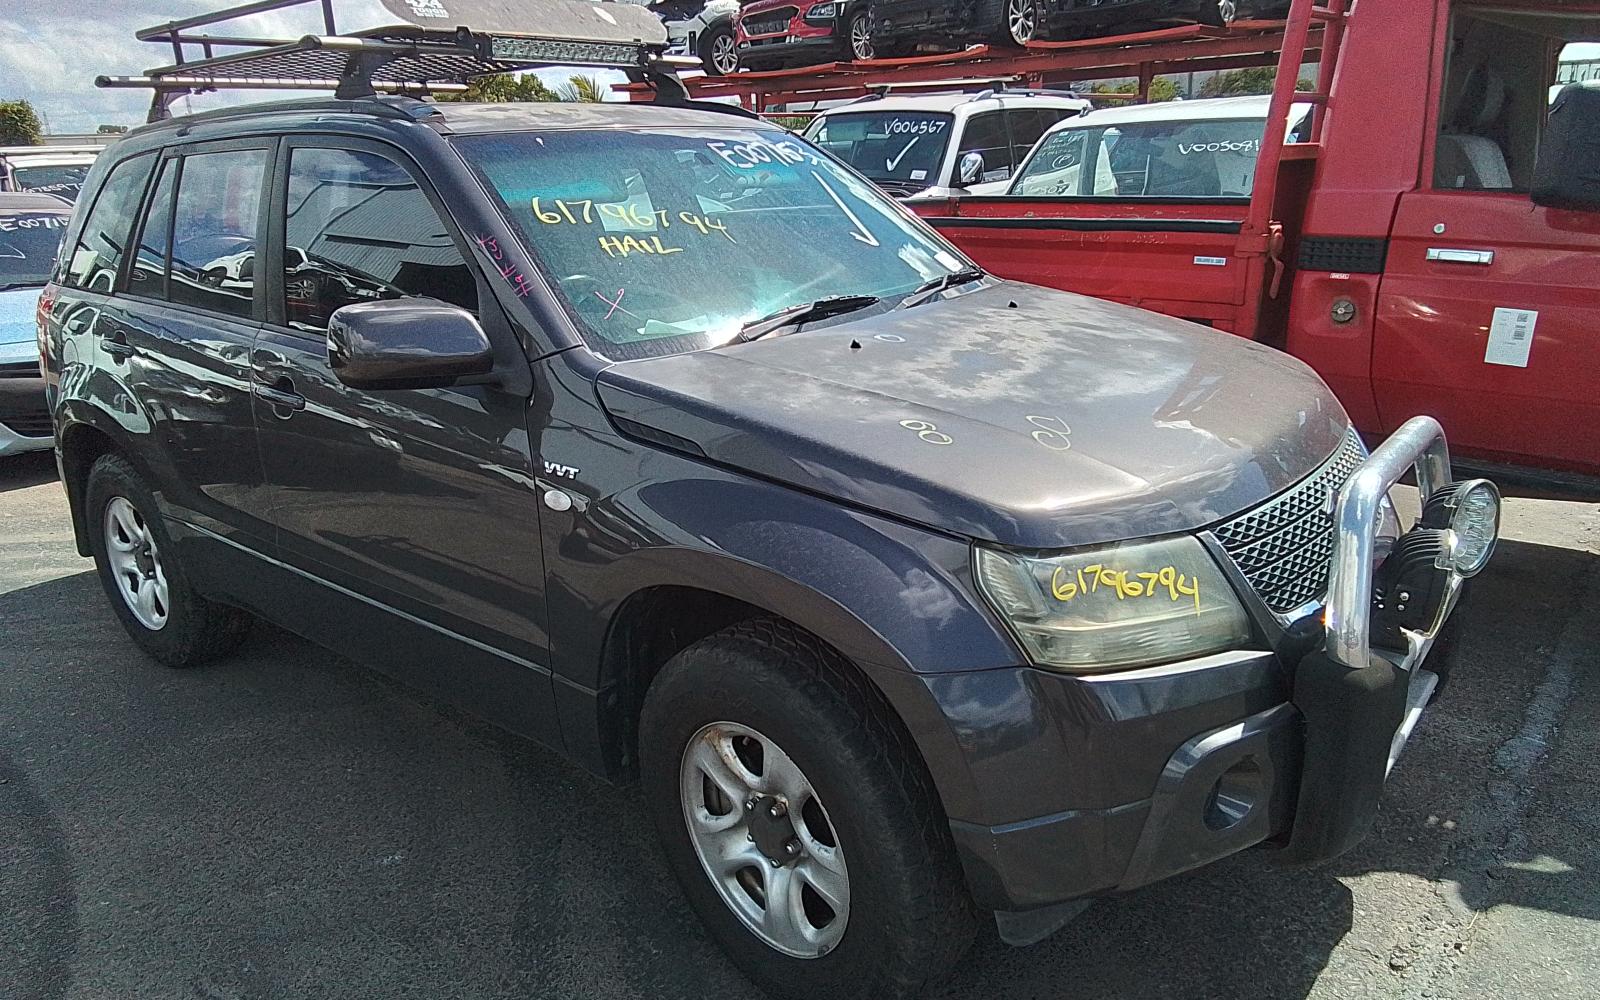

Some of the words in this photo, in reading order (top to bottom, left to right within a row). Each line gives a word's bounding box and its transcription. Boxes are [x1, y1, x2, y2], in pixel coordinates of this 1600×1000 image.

[884, 118, 946, 135] V006567
[598, 235, 684, 259] HAIL
[544, 461, 580, 480] VVT
[1051, 564, 1202, 618] 61796794
